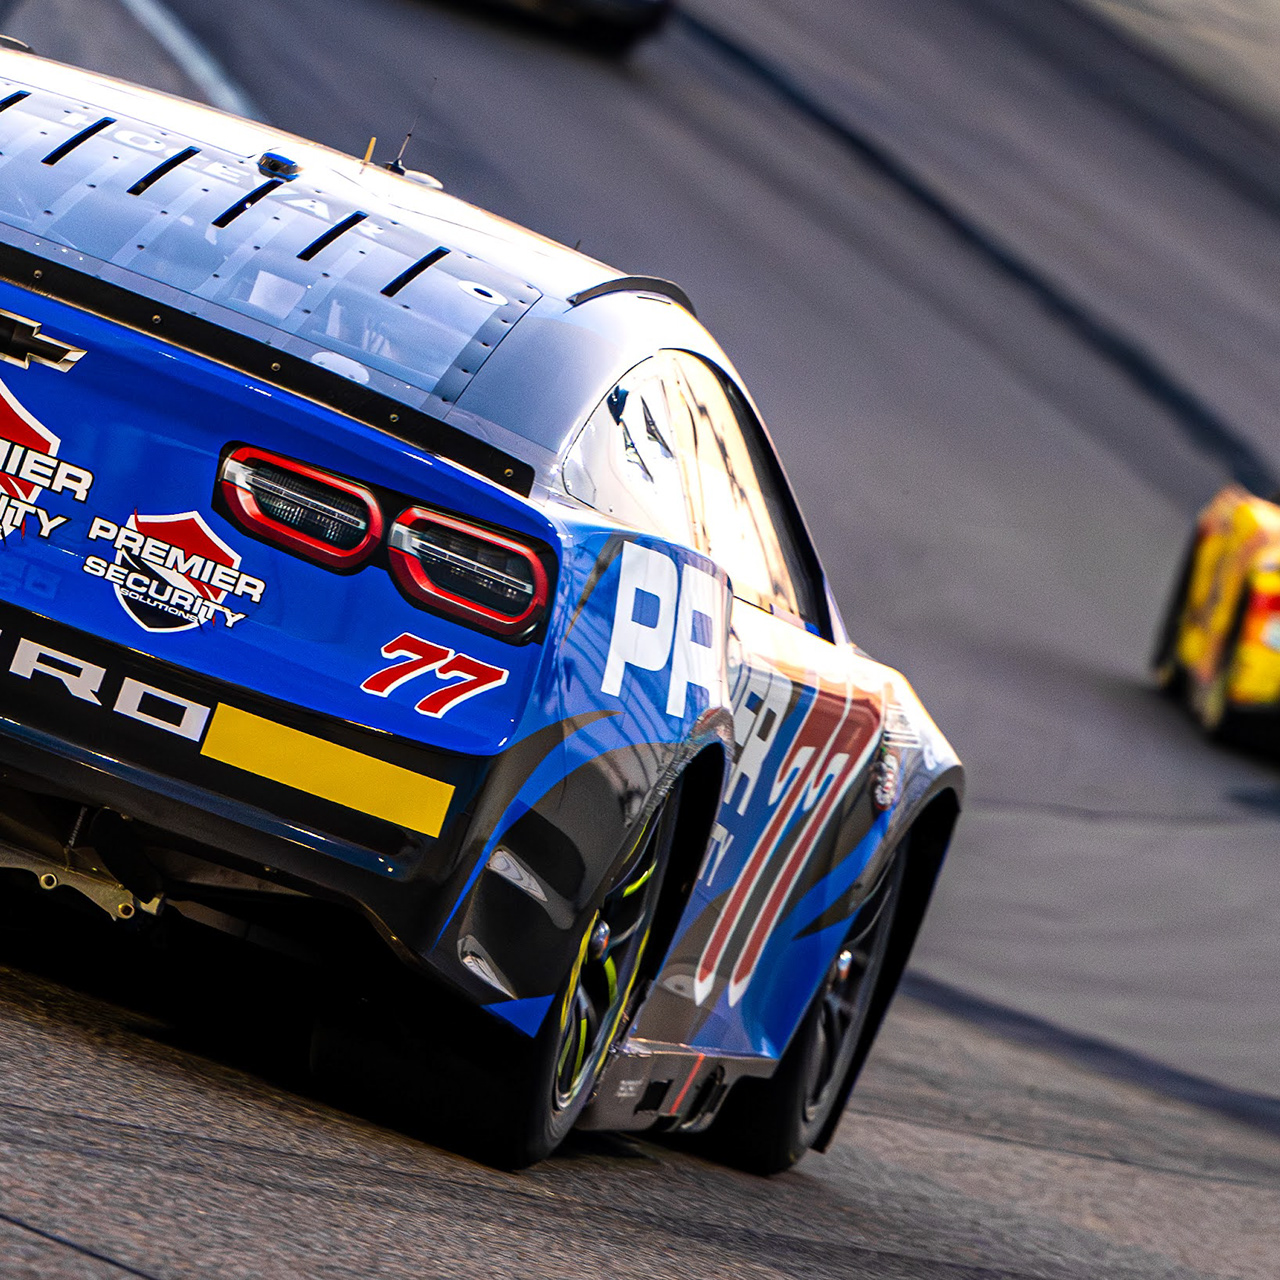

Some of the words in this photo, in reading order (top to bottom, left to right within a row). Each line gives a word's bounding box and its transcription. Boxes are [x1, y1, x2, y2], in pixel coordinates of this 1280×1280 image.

[82, 555, 247, 628] SECURITY
[87, 516, 266, 604] PREMIER
[120, 587, 198, 624] SOLUTIONS
[360, 632, 510, 718] 77
[694, 670, 884, 1008] 77
